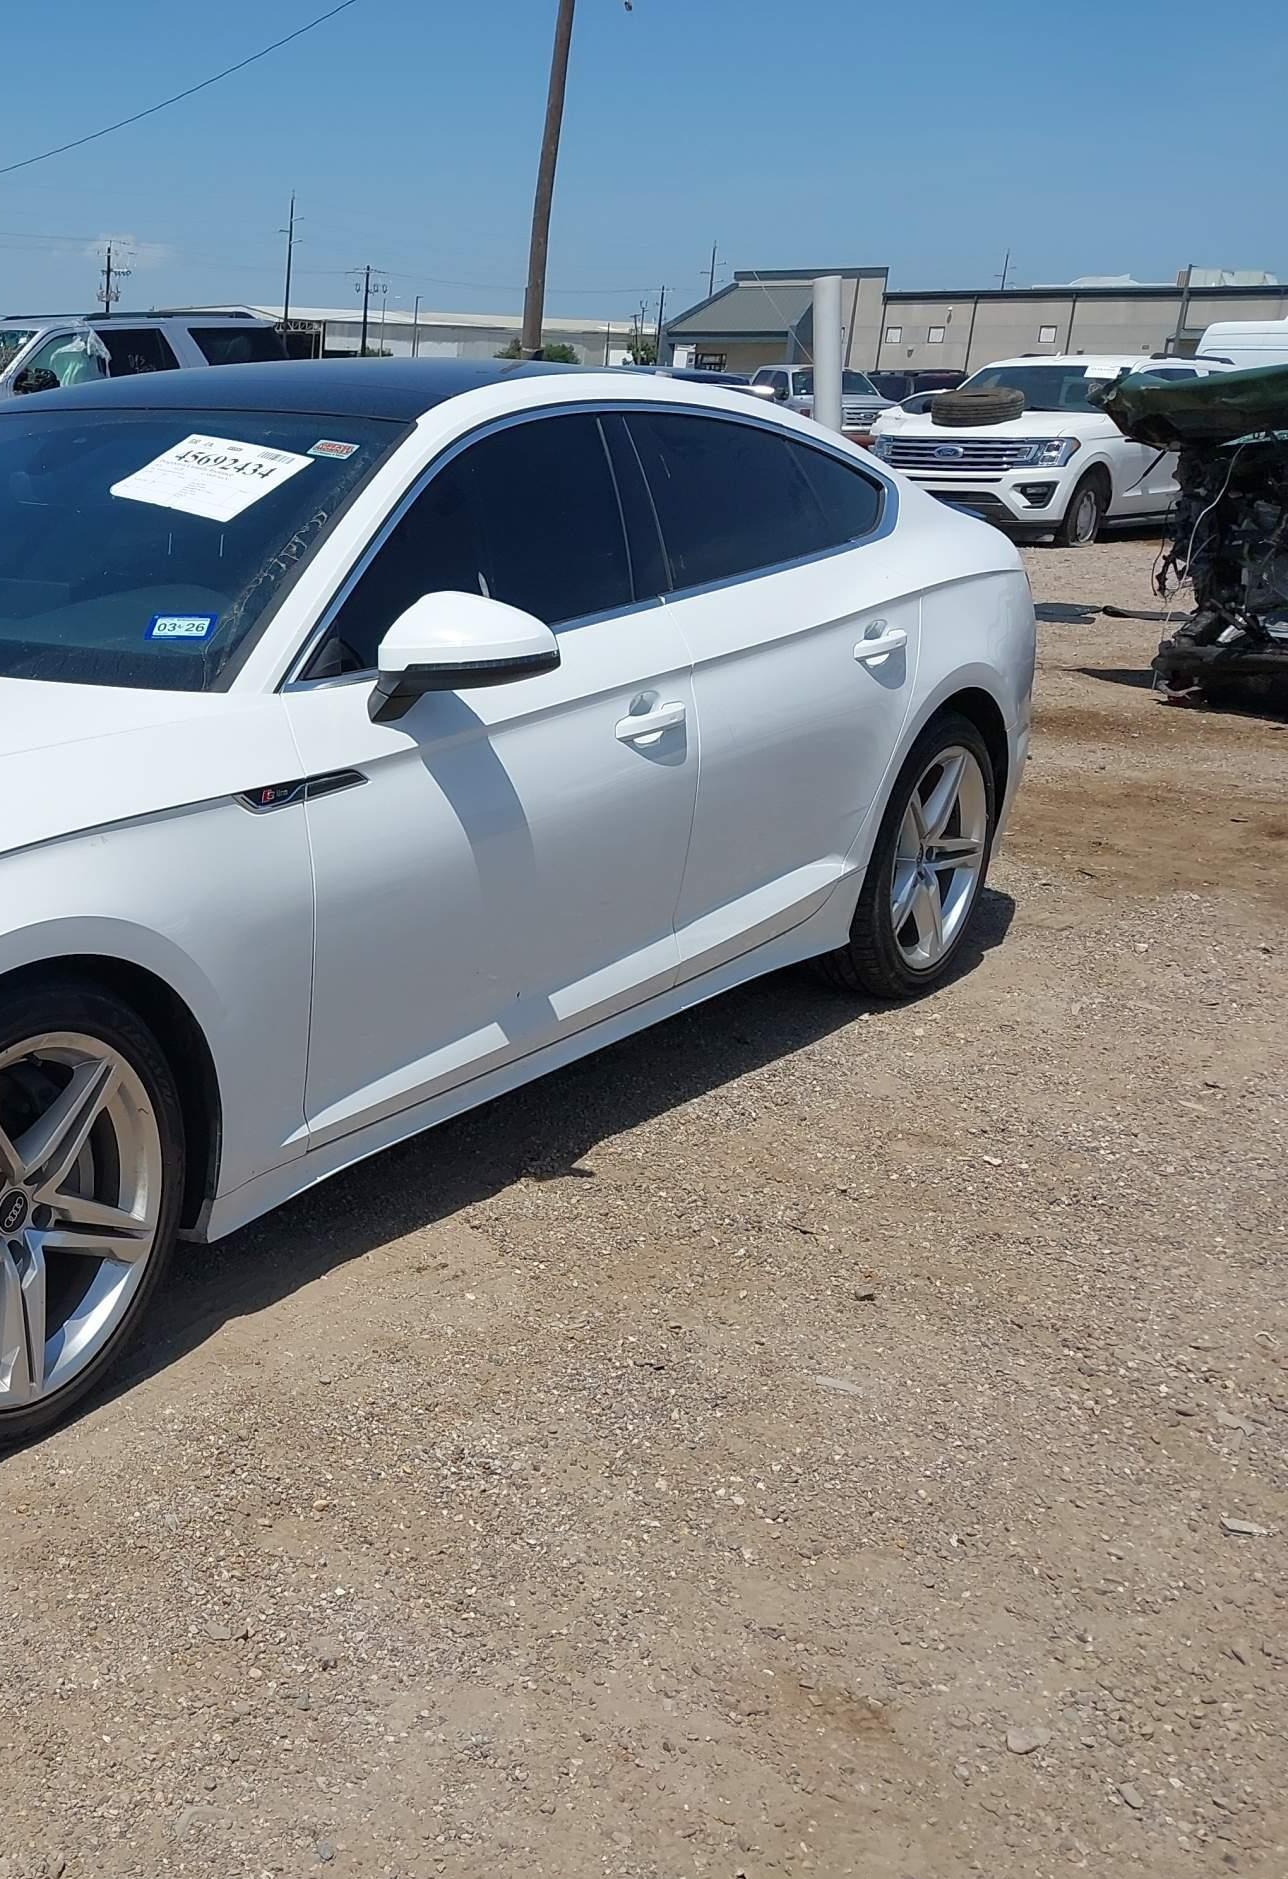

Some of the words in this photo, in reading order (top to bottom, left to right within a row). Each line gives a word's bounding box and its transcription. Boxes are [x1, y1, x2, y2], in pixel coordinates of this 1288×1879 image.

[175, 450, 279, 479] 45692434
[157, 622, 177, 632] 03
[184, 622, 207, 632] 26
